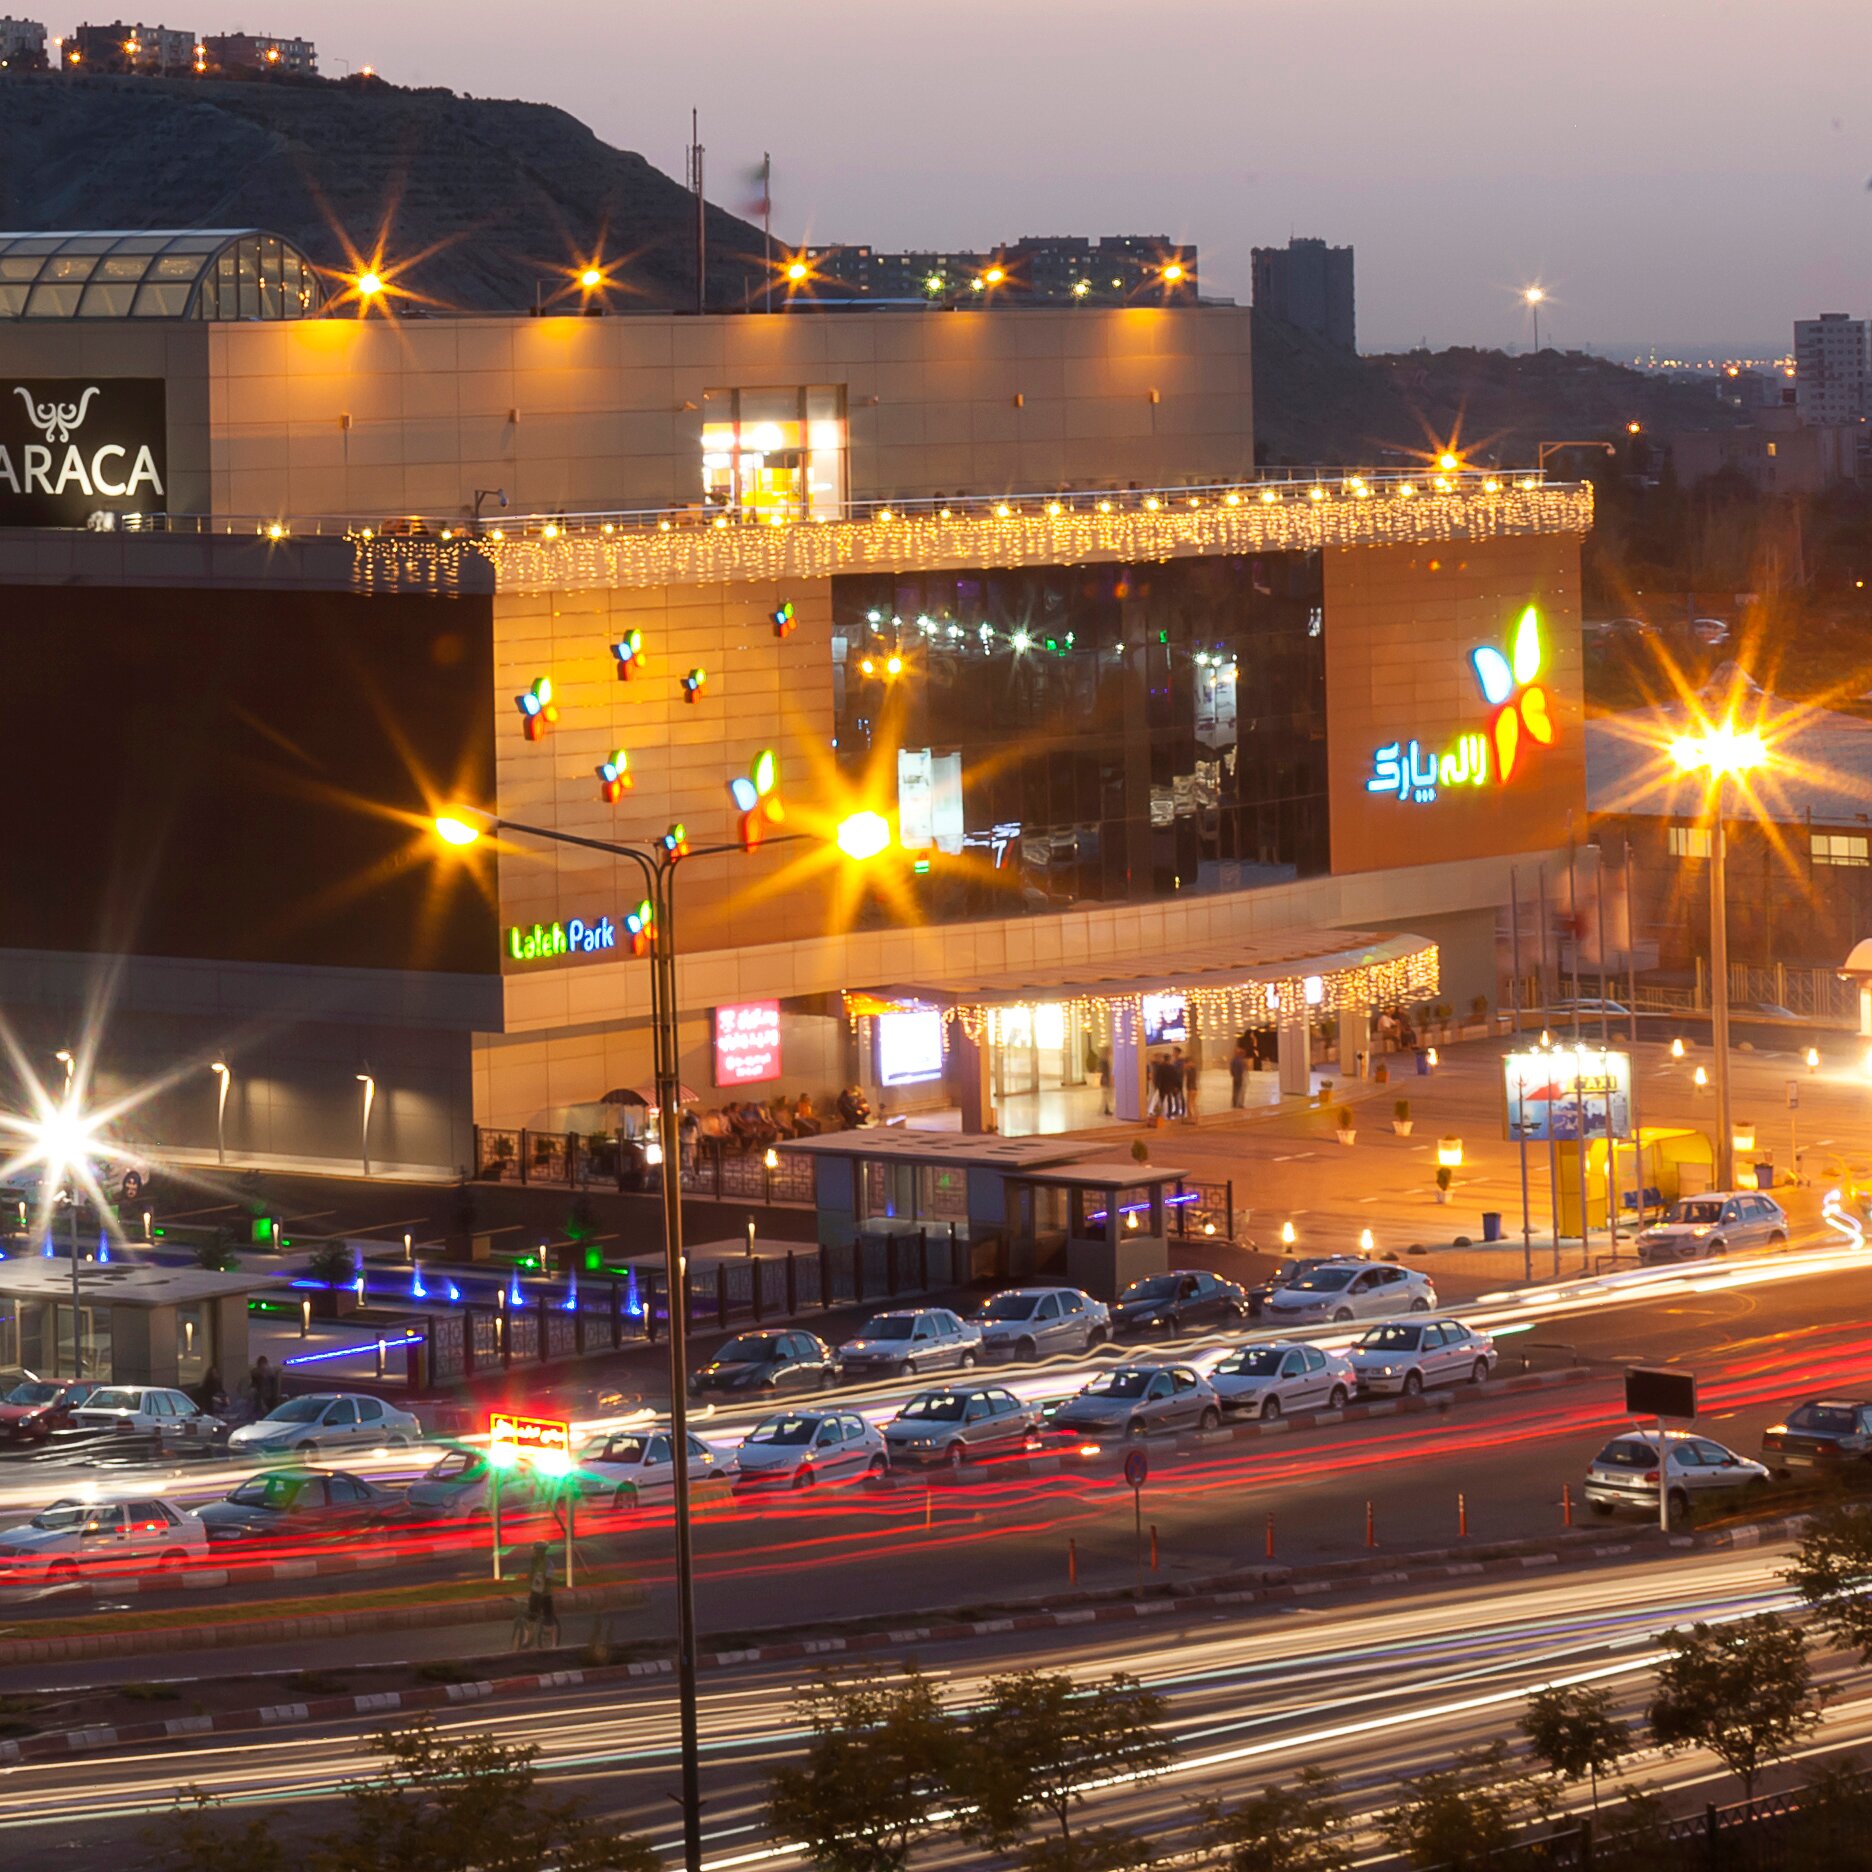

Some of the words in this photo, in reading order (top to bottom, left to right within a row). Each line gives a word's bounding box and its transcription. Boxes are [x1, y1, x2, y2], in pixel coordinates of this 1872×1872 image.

[1439, 733, 1487, 787] لاله
[510, 921, 568, 960] Laleh
[569, 916, 615, 953] Park
